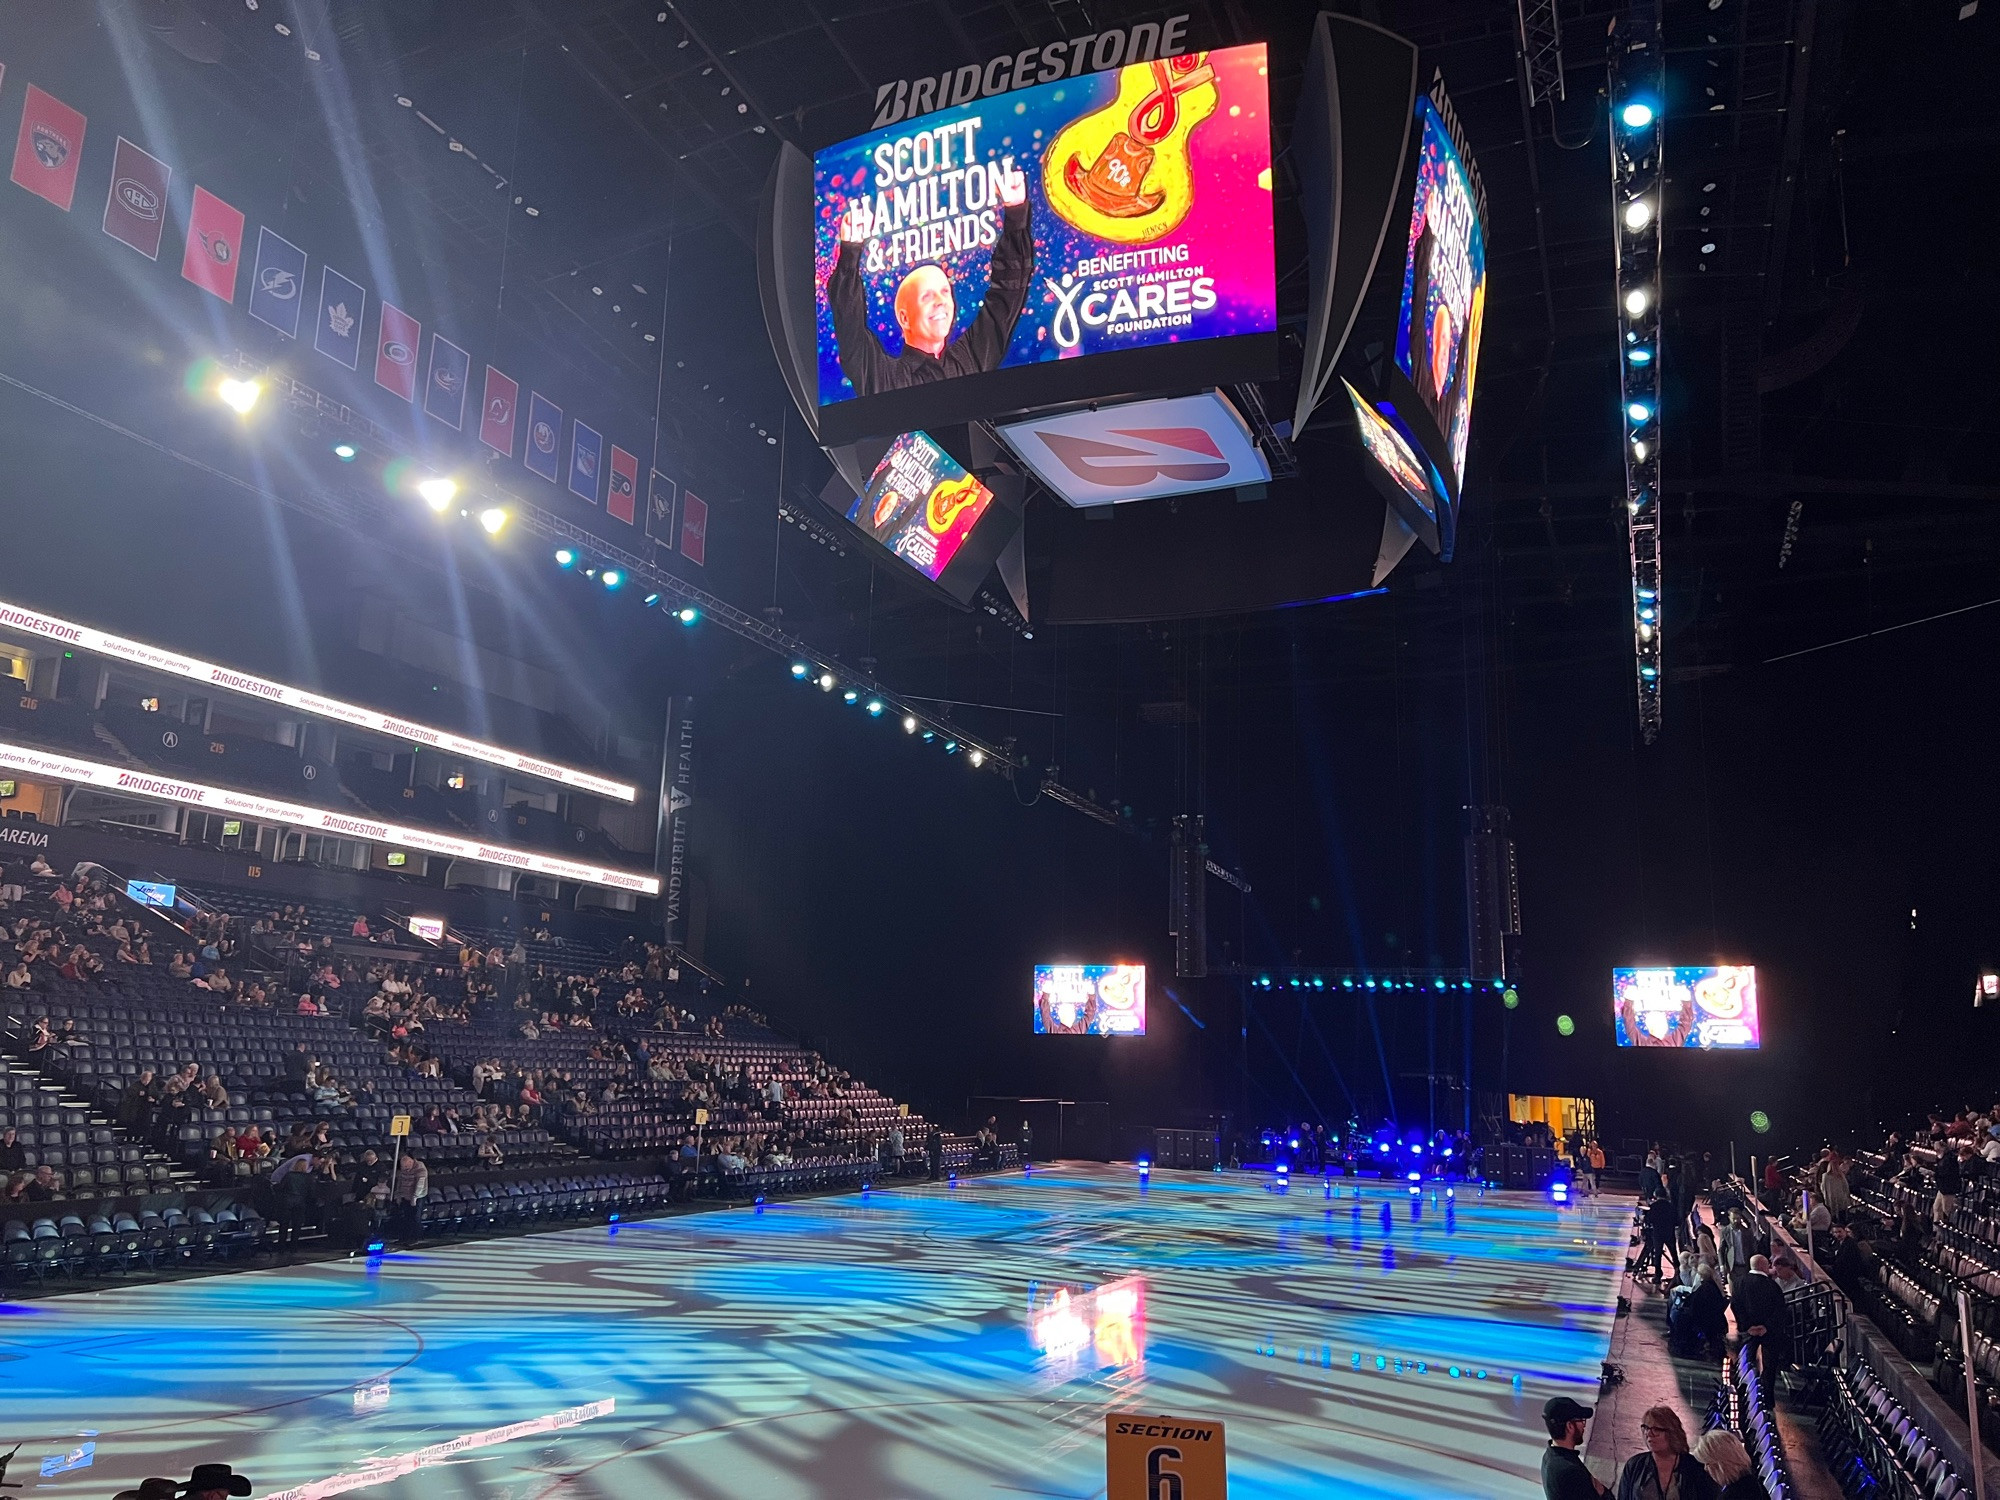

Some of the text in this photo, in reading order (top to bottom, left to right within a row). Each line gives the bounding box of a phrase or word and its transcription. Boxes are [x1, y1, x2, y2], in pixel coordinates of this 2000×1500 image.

[871, 14, 1190, 130] BRIDGESTONE
[874, 116, 982, 188] SCOTT
[849, 156, 1015, 239] HAMILTON
[1444, 159, 1474, 252] SCOTT
[866, 209, 997, 272] & FRIENDS
[1078, 244, 1188, 278] BENEFITTING
[1093, 266, 1204, 292] SCOTT HAMILTON
[1080, 277, 1217, 326] CARES
[1107, 313, 1192, 335] FOUNDATION
[909, 436, 940, 469] SCOTT
[905, 538, 936, 565] CARES
[0, 606, 82, 642] RIDGESTONE
[102, 640, 135, 655] Solutions
[137, 650, 147, 658] for
[148, 654, 164, 663] your
[164, 659, 192, 672] journey
[211, 669, 284, 700] BRIDGESTONE
[299, 697, 325, 710] Solutions
[382, 719, 439, 744] BRIDGESTONE
[517, 758, 563, 779] BRIDGESTONE
[20, 696, 38, 710] 216
[0, 827, 48, 848] ARENA
[28, 757, 41, 766] for
[41, 761, 61, 771] your
[61, 764, 94, 779] journey
[117, 773, 206, 802] BRIDGESTONE
[224, 797, 254, 810] Solutions
[255, 803, 265, 811] for
[265, 807, 281, 815] your
[280, 809, 304, 820] journey
[321, 815, 388, 838] BRIDGESTONE
[402, 833, 425, 845] Solutions
[478, 847, 530, 867] BRIDGESTONE
[602, 872, 644, 889] BRIDGESTONE
[667, 719, 693, 923] VANDERBILT HEALTH
[248, 865, 262, 878] 115
[397, 1120, 404, 1134] 3
[1115, 1422, 1213, 1442] SECTION
[1146, 1445, 1183, 1500] 6
